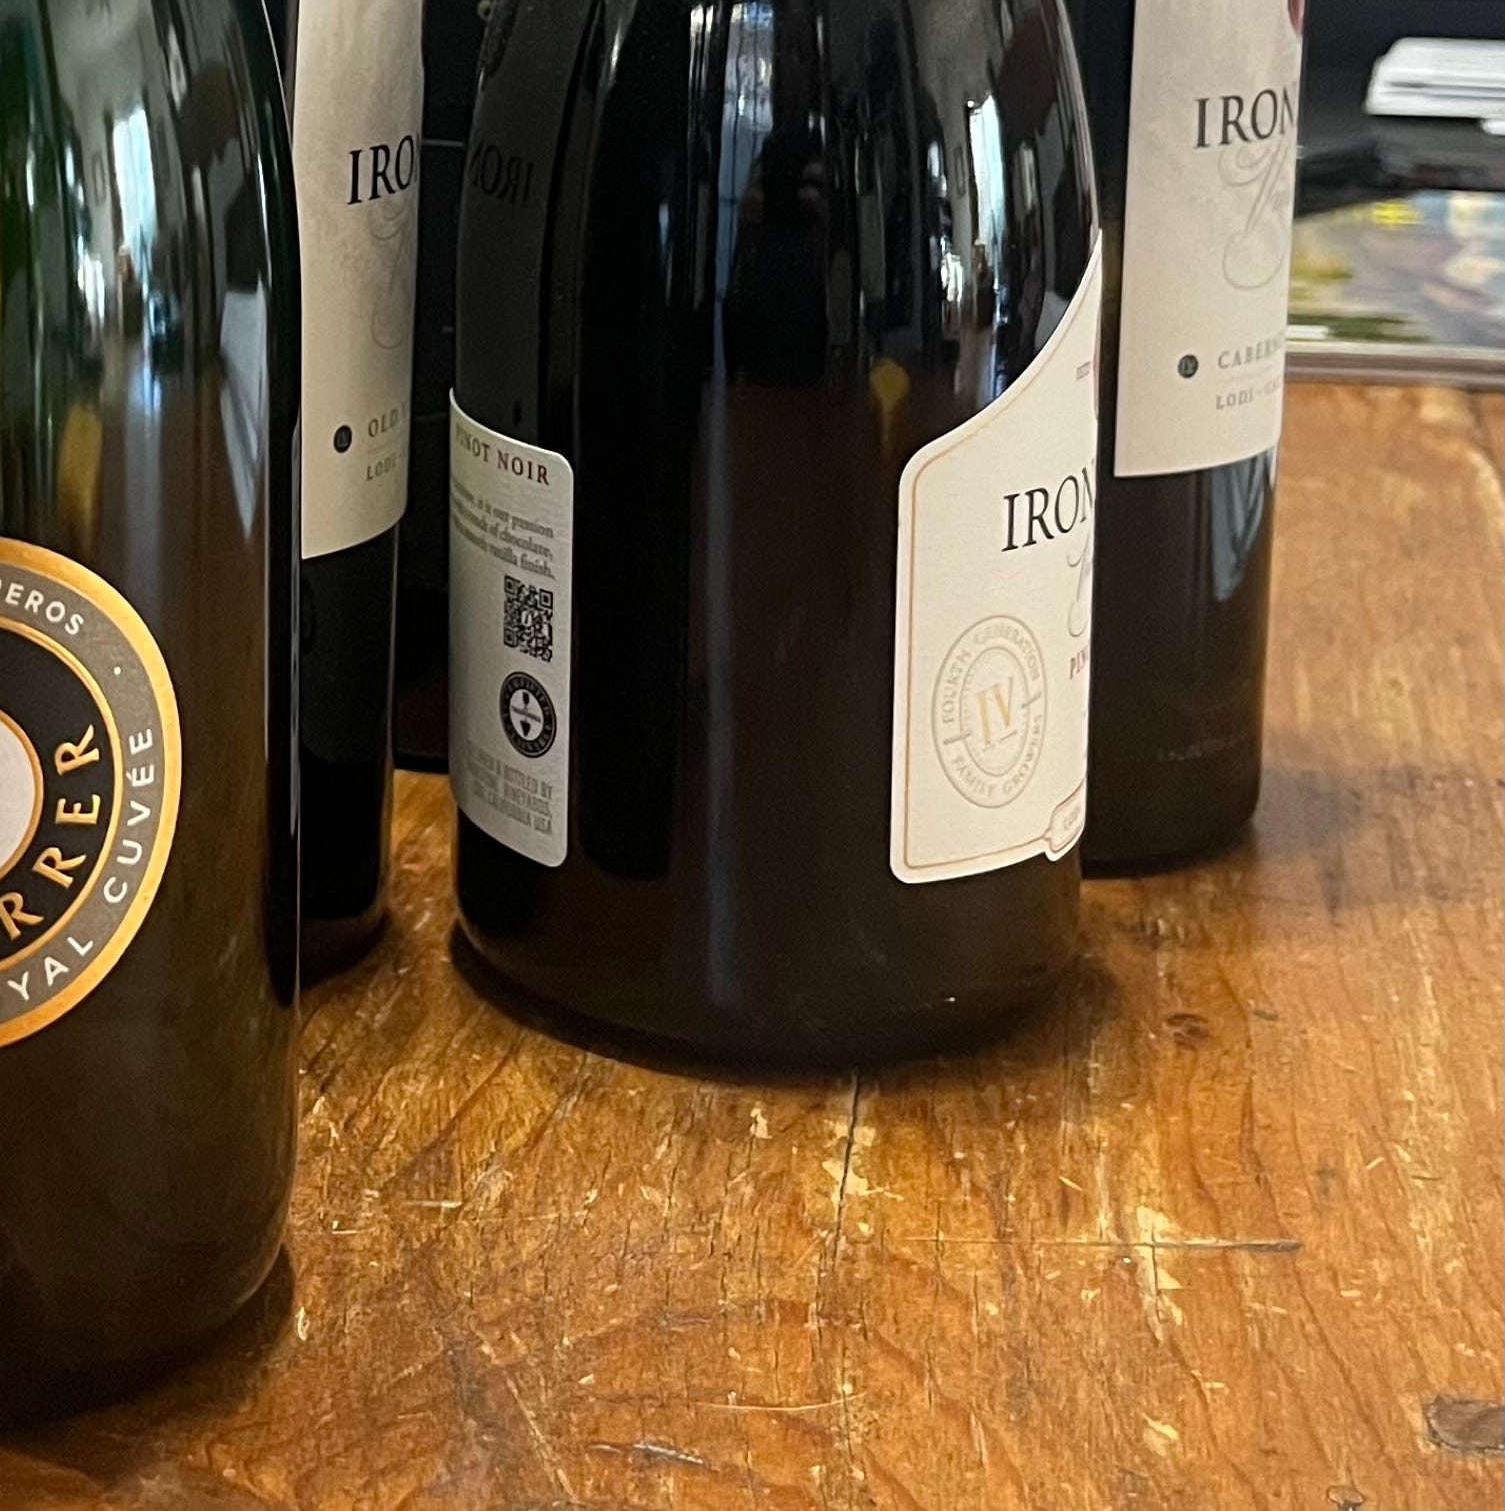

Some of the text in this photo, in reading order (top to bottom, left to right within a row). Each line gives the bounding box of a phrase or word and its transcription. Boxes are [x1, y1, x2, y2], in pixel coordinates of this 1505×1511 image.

[497, 449, 549, 486] NOIR
[520, 552, 556, 582] finish.
[103, 728, 153, 905] CUVÉE
